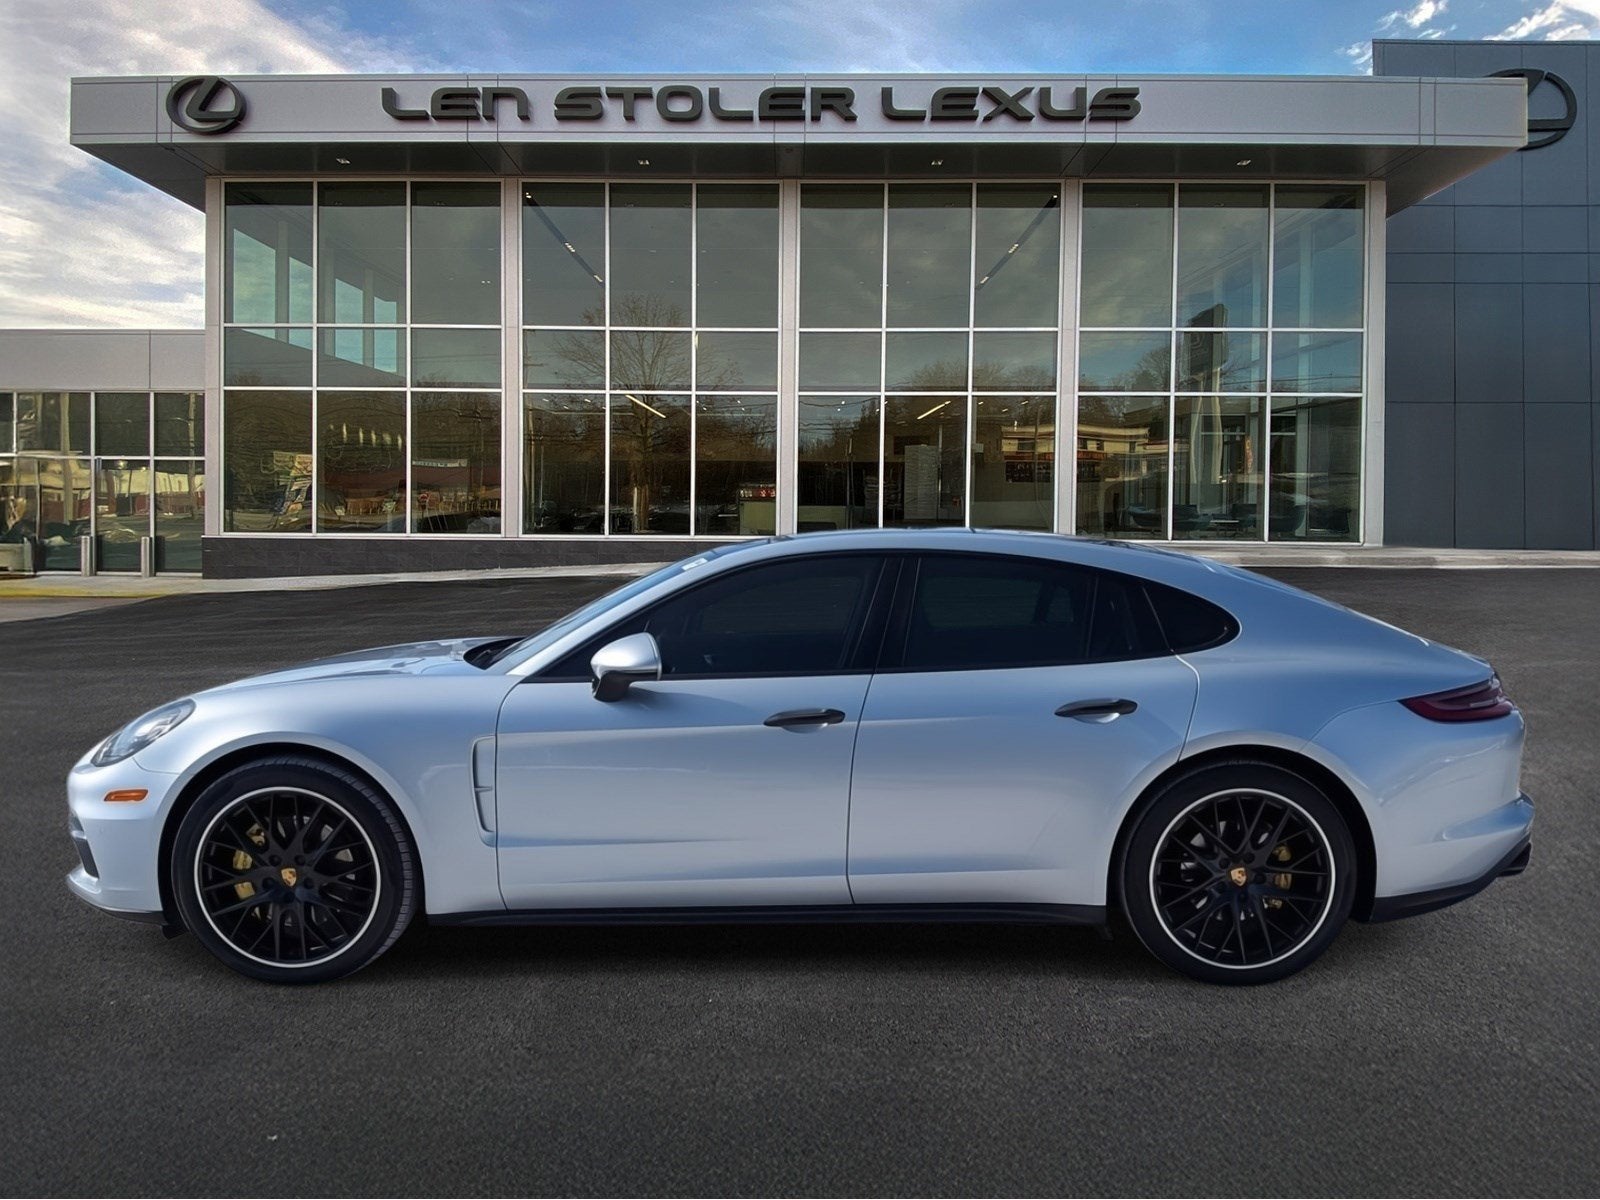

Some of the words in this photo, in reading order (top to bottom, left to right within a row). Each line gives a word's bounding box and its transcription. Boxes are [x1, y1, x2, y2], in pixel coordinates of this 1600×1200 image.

[381, 87, 530, 121] LEN
[554, 85, 858, 122] STOLER
[881, 86, 1142, 122] LEXUS
